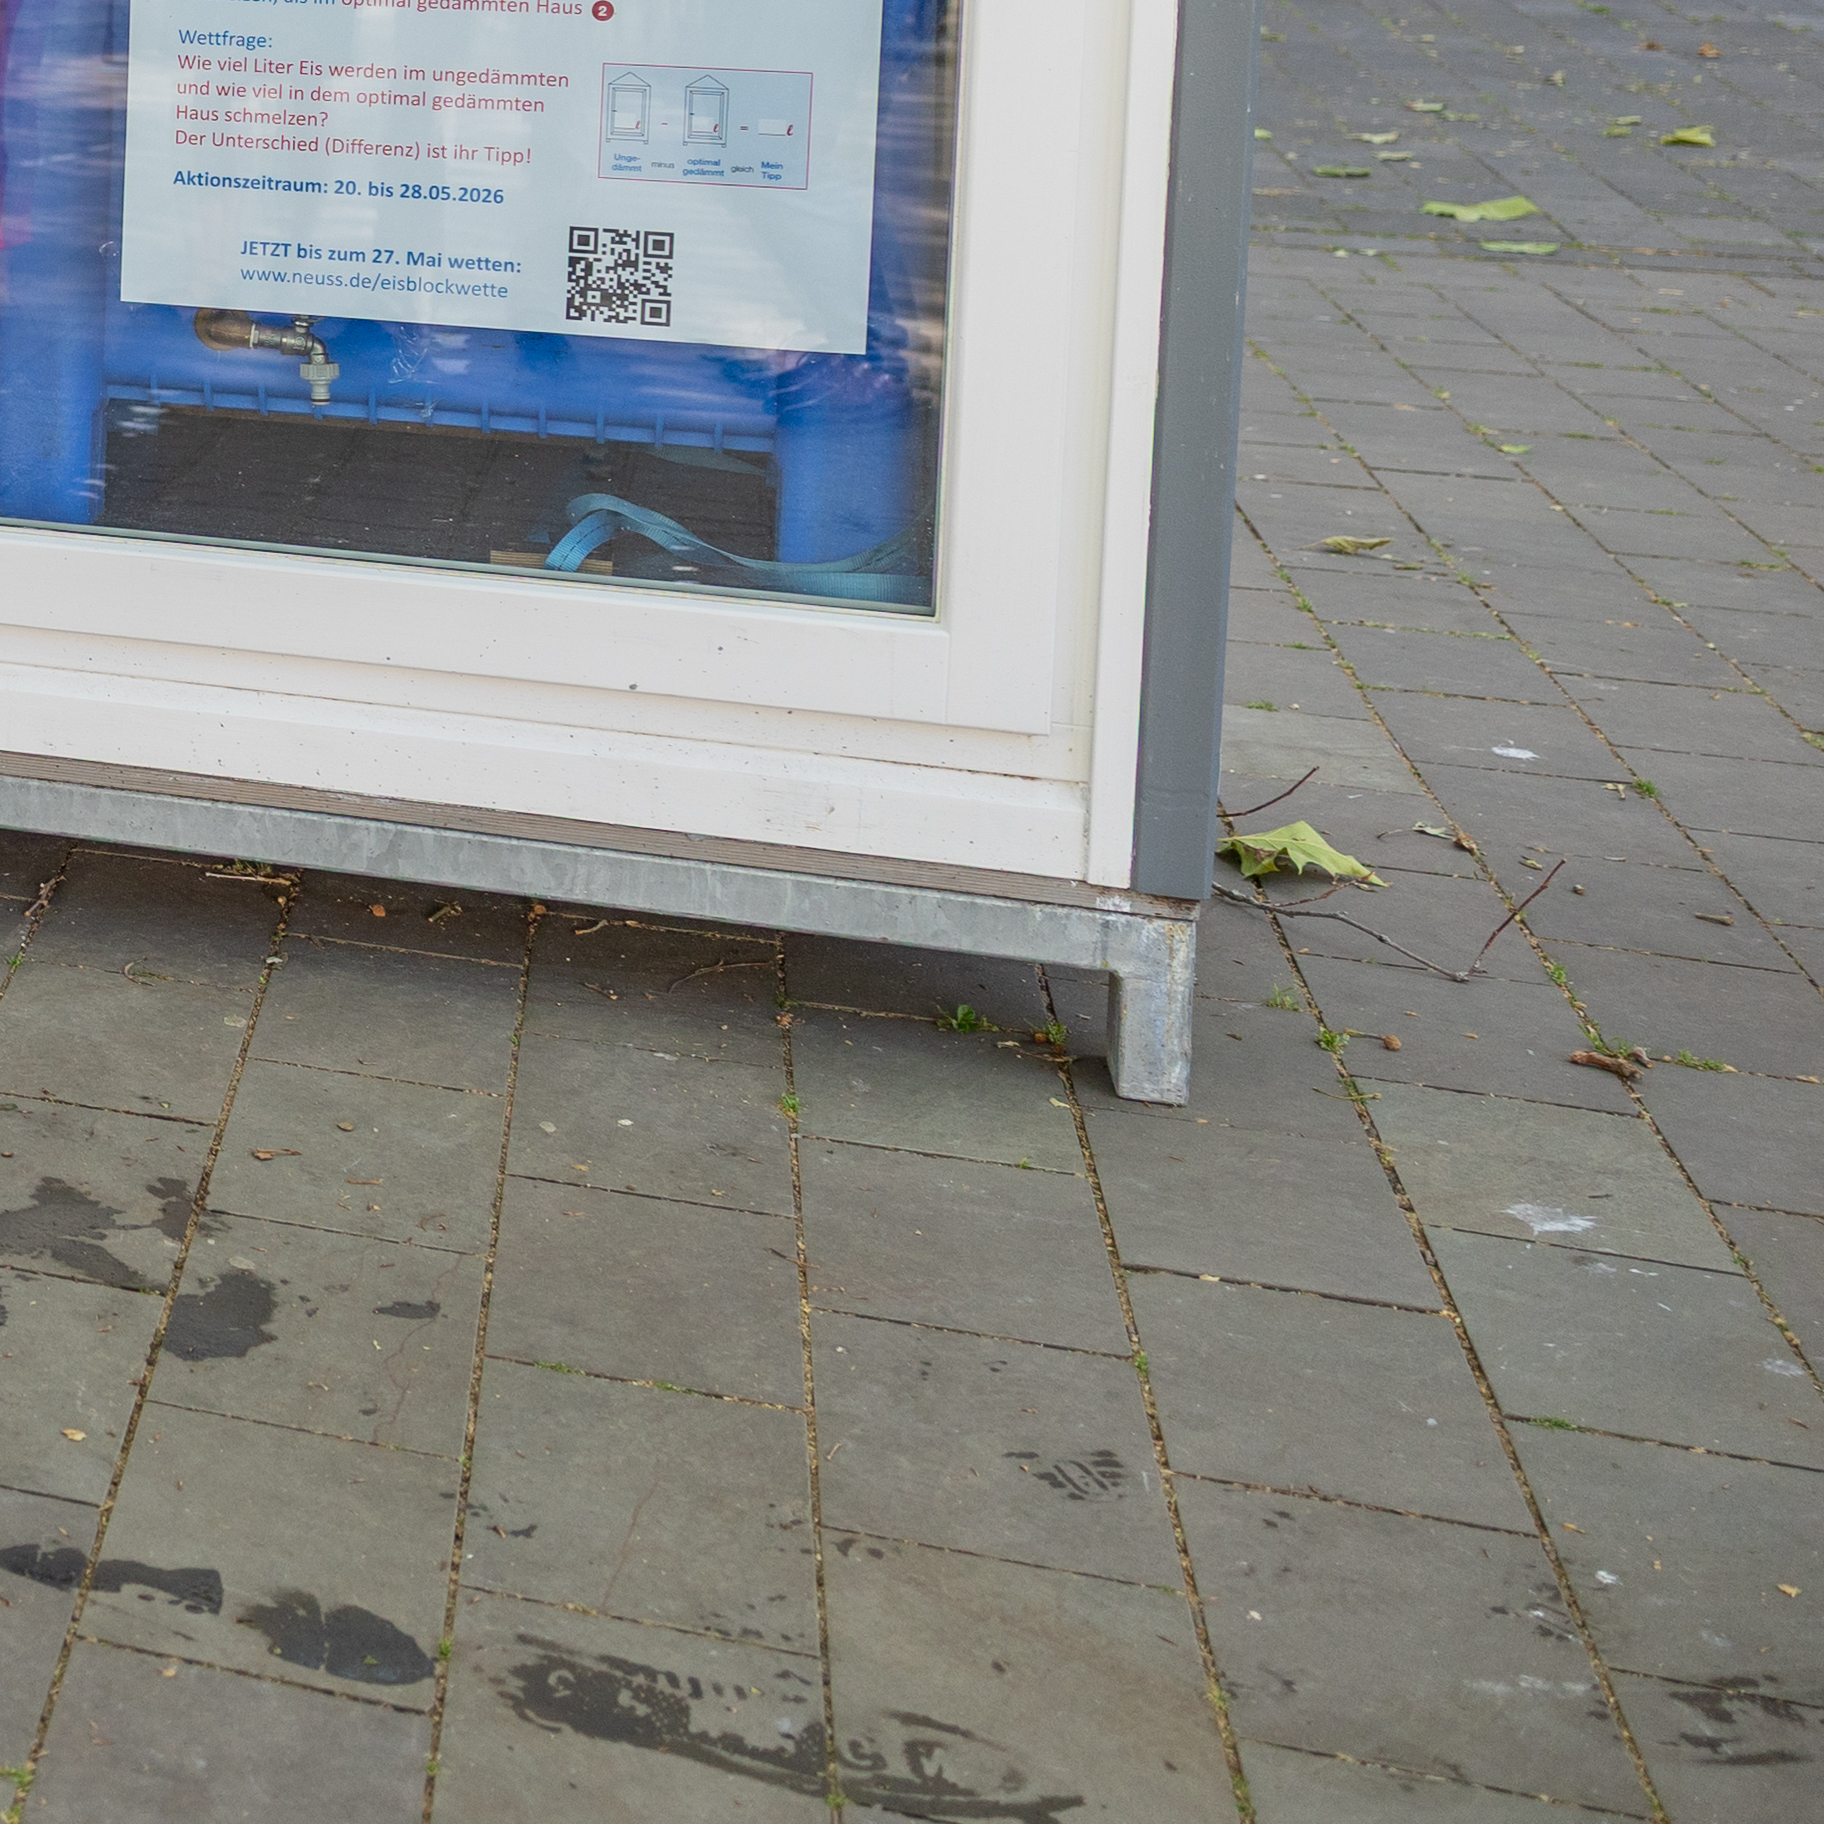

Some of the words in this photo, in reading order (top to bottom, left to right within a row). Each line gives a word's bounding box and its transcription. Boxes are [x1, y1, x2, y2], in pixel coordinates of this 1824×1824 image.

[178, 29, 272, 51] Wettfrage:
[177, 54, 212, 71] Wie
[217, 56, 247, 72] viel
[254, 58, 294, 74] Liter
[299, 60, 323, 76] Eis
[328, 63, 397, 80] werden
[403, 65, 426, 81] im
[432, 68, 569, 87] ungedämmten
[177, 80, 210, 96] und
[216, 82, 247, 98] wie
[252, 83, 282, 99] viel
[289, 85, 304, 101] in
[310, 86, 350, 102] dem
[356, 89, 426, 108] optimal
[432, 93, 544, 112] gedämmten
[176, 105, 219, 121] Haus
[224, 107, 329, 127] schmelzen?
[175, 129, 207, 146] Der
[212, 132, 319, 152] Unterschied
[325, 137, 420, 161] (Differenz)
[427, 143, 448, 159] ist
[454, 144, 479, 160] ihr
[483, 146, 531, 166] Tipp!
[173, 170, 328, 194] Aktionszeitraum:
[334, 179, 361, 196] 20.
[368, 181, 394, 198] bis
[399, 183, 504, 204] 28.05.2026
[240, 240, 292, 258] JETZT
[297, 242, 322, 260] bis
[327, 249, 366, 263] zum
[372, 248, 400, 265] 27.
[406, 250, 442, 268] Mai
[447, 256, 521, 273] wetten:
[240, 268, 508, 298] www.neuss.de/eisblockwette
